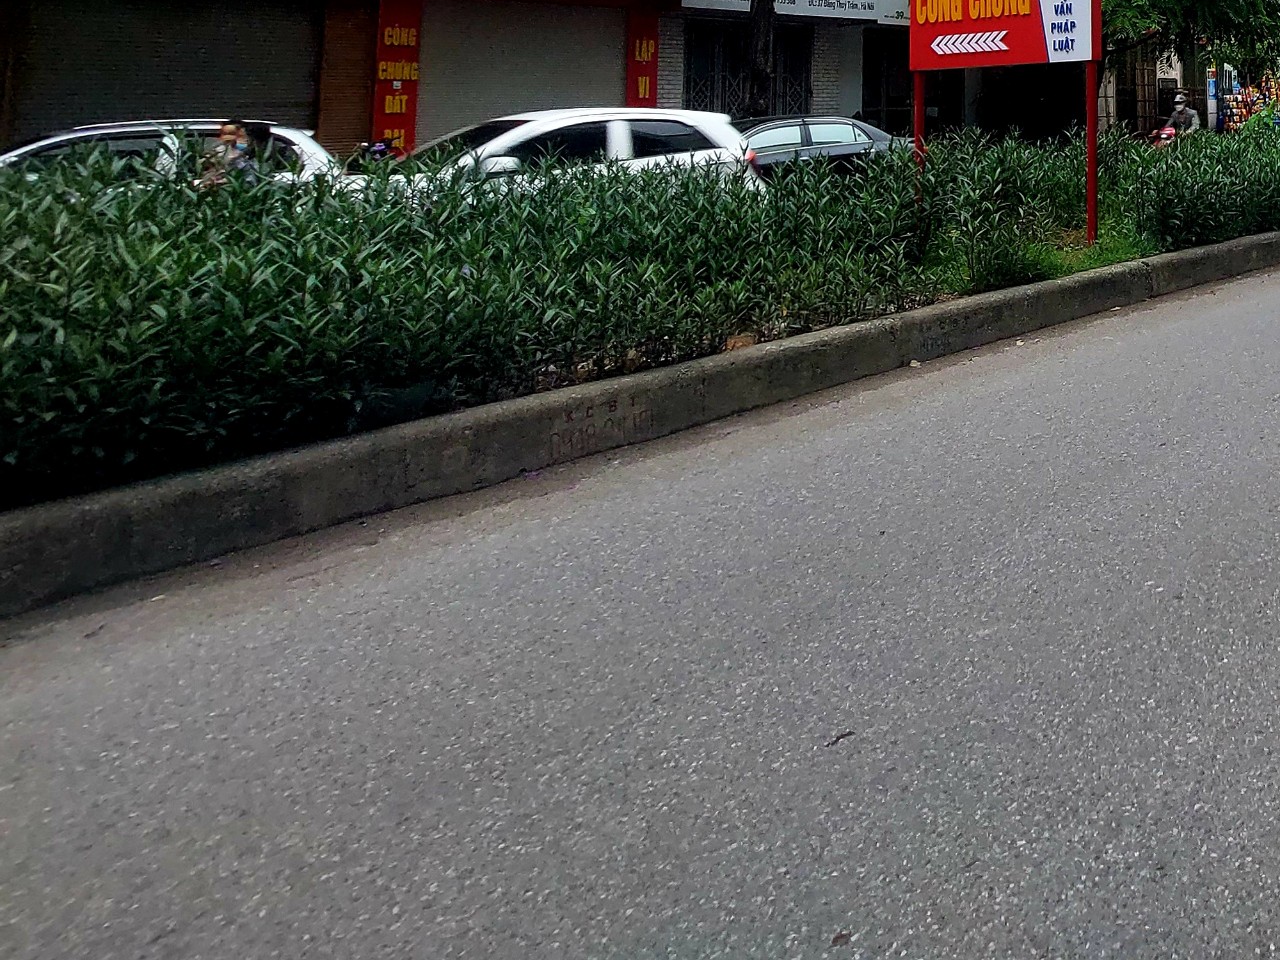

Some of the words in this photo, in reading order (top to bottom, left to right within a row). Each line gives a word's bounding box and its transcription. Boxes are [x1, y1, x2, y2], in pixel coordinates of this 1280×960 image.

[1053, 0, 1073, 16] VẤN
[384, 23, 417, 46] CÔNG
[1050, 18, 1077, 35] PHÁP
[635, 37, 655, 64] LẬP
[1052, 36, 1076, 54] LUẬT
[378, 59, 419, 80] CHỨNG
[638, 76, 650, 98] VI
[385, 90, 408, 114] ĐẤT
